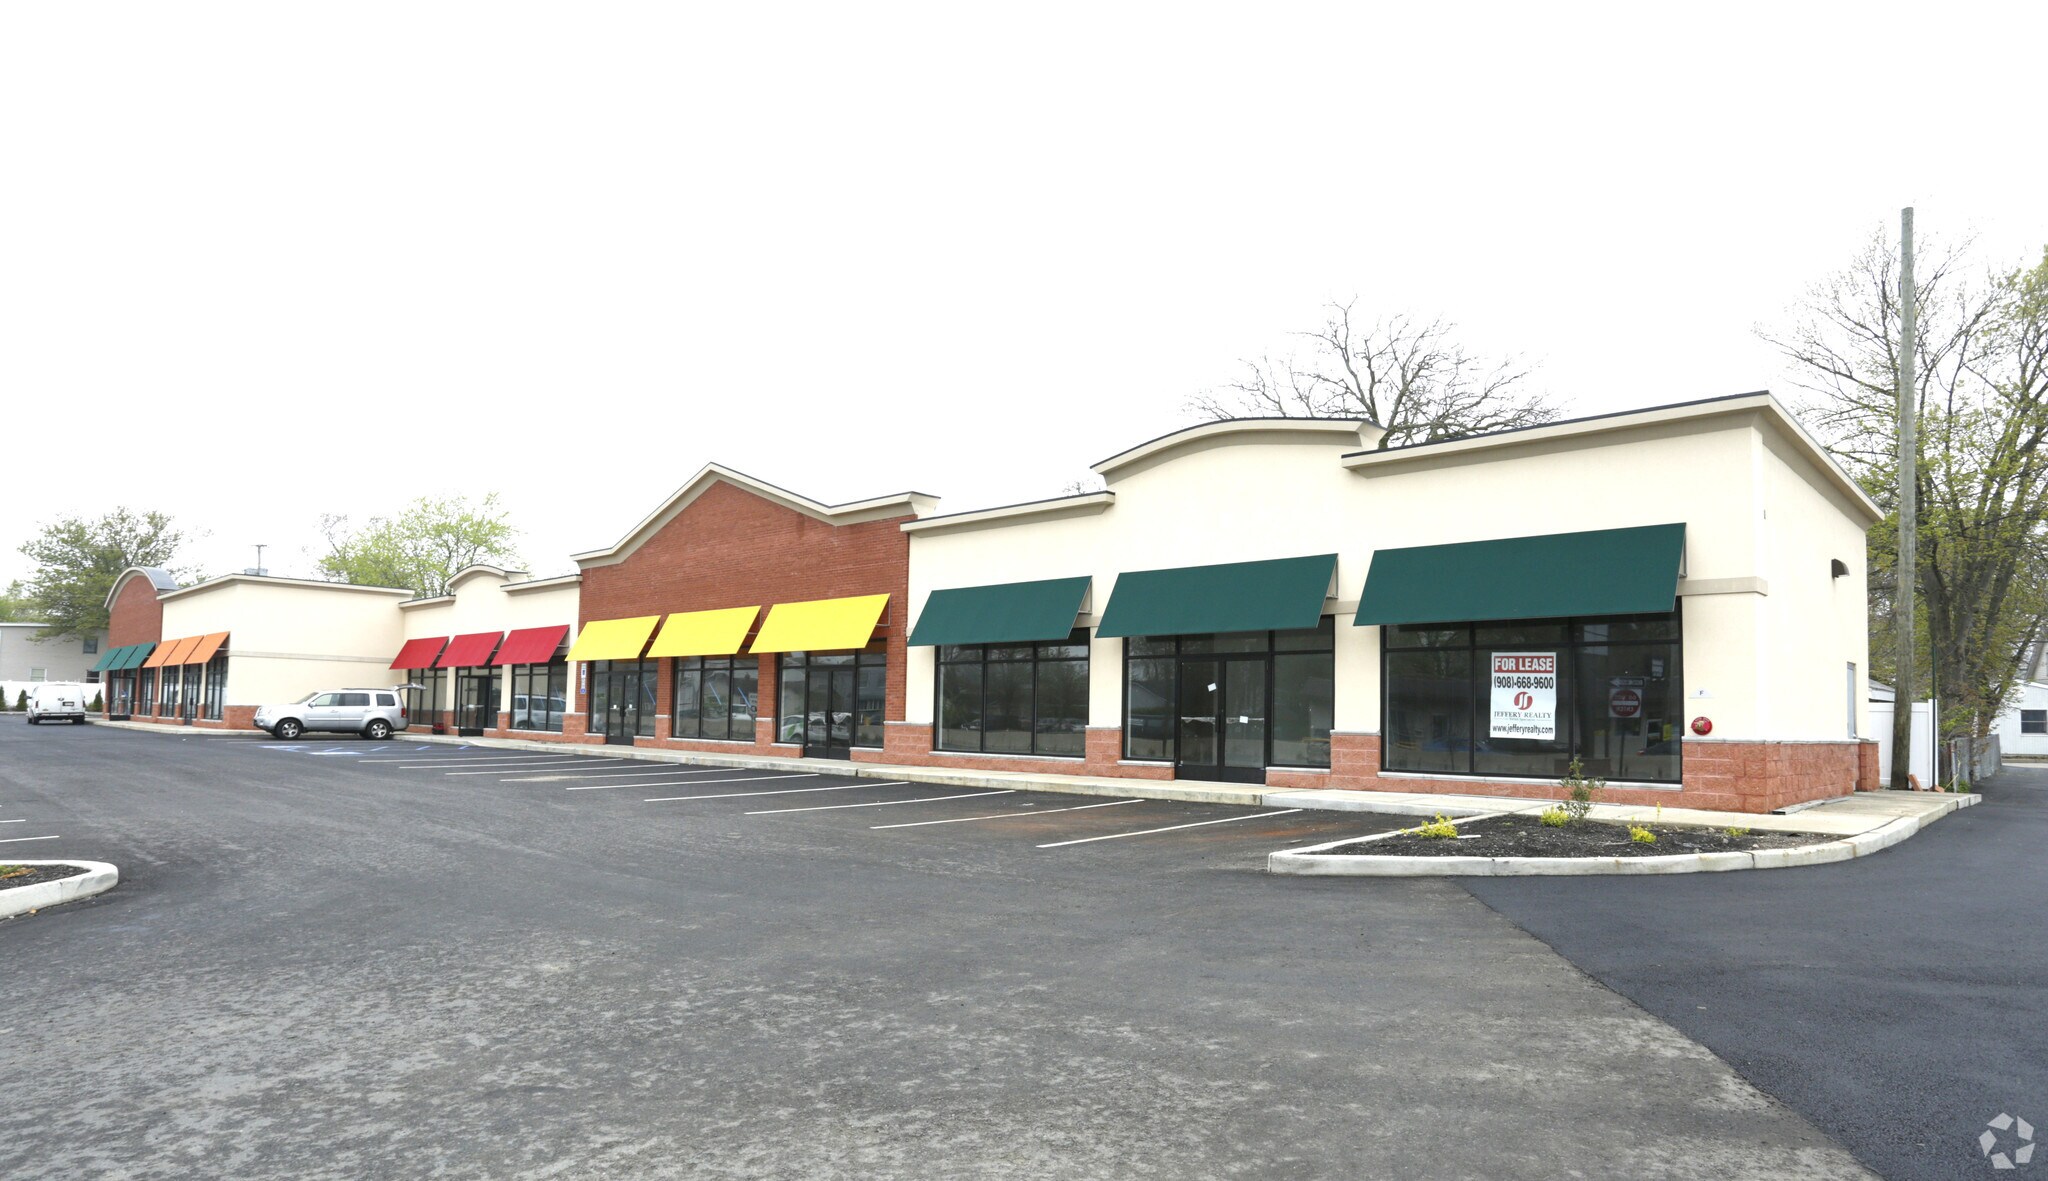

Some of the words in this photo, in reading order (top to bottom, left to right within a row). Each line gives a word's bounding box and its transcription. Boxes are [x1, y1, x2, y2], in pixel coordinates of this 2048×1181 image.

[1494, 657, 1516, 671] FOR
[1519, 657, 1553, 671] LEASE
[1524, 711, 1552, 719] REALTY
[1492, 723, 1554, 736] www.jefferyrealty.com
